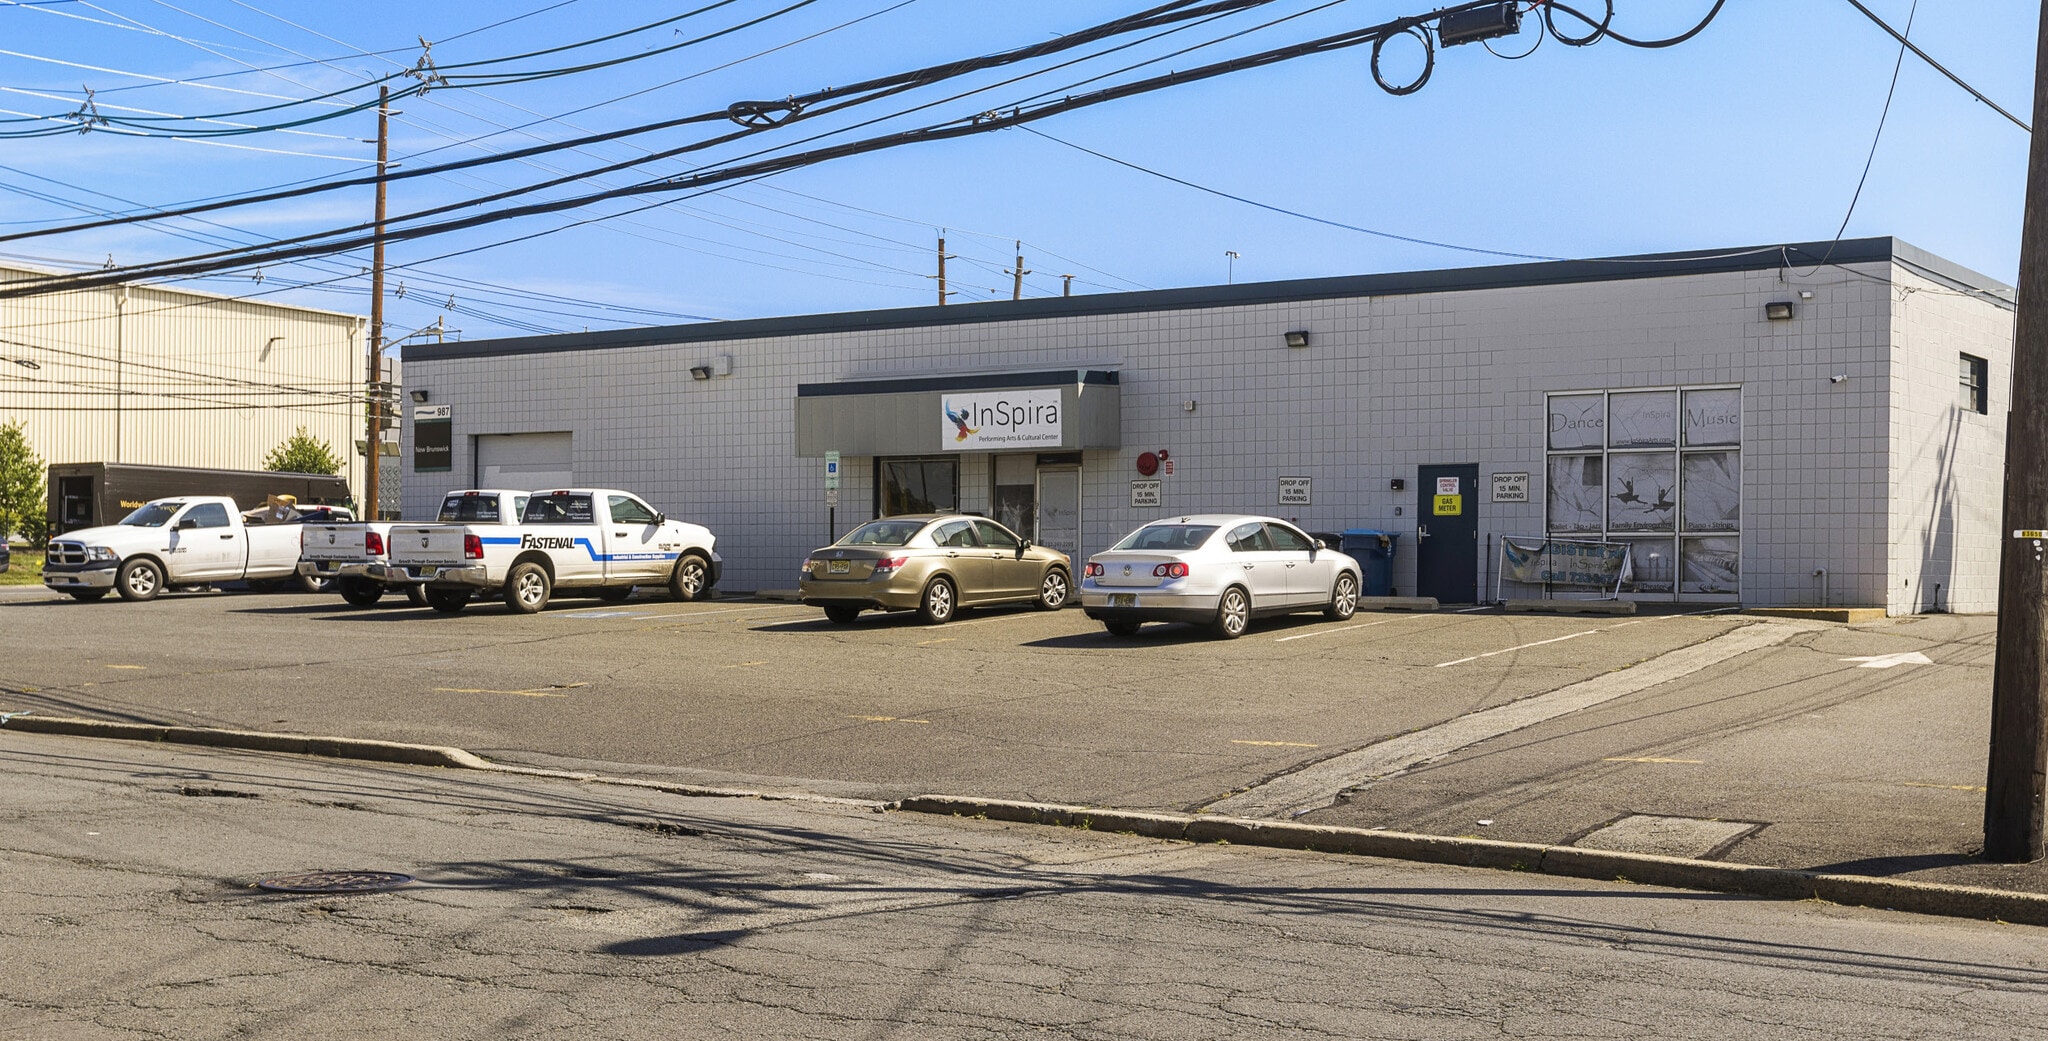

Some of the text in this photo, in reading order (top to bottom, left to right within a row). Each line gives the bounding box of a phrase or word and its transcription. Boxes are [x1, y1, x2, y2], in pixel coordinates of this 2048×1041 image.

[437, 407, 449, 416] 987
[974, 400, 1057, 433] InSpira
[1687, 408, 1740, 428] Music
[1551, 413, 1604, 433] Dance
[1514, 475, 1526, 483] OFF
[1535, 543, 1605, 558] EGISTER
[1541, 570, 1566, 581] Call
